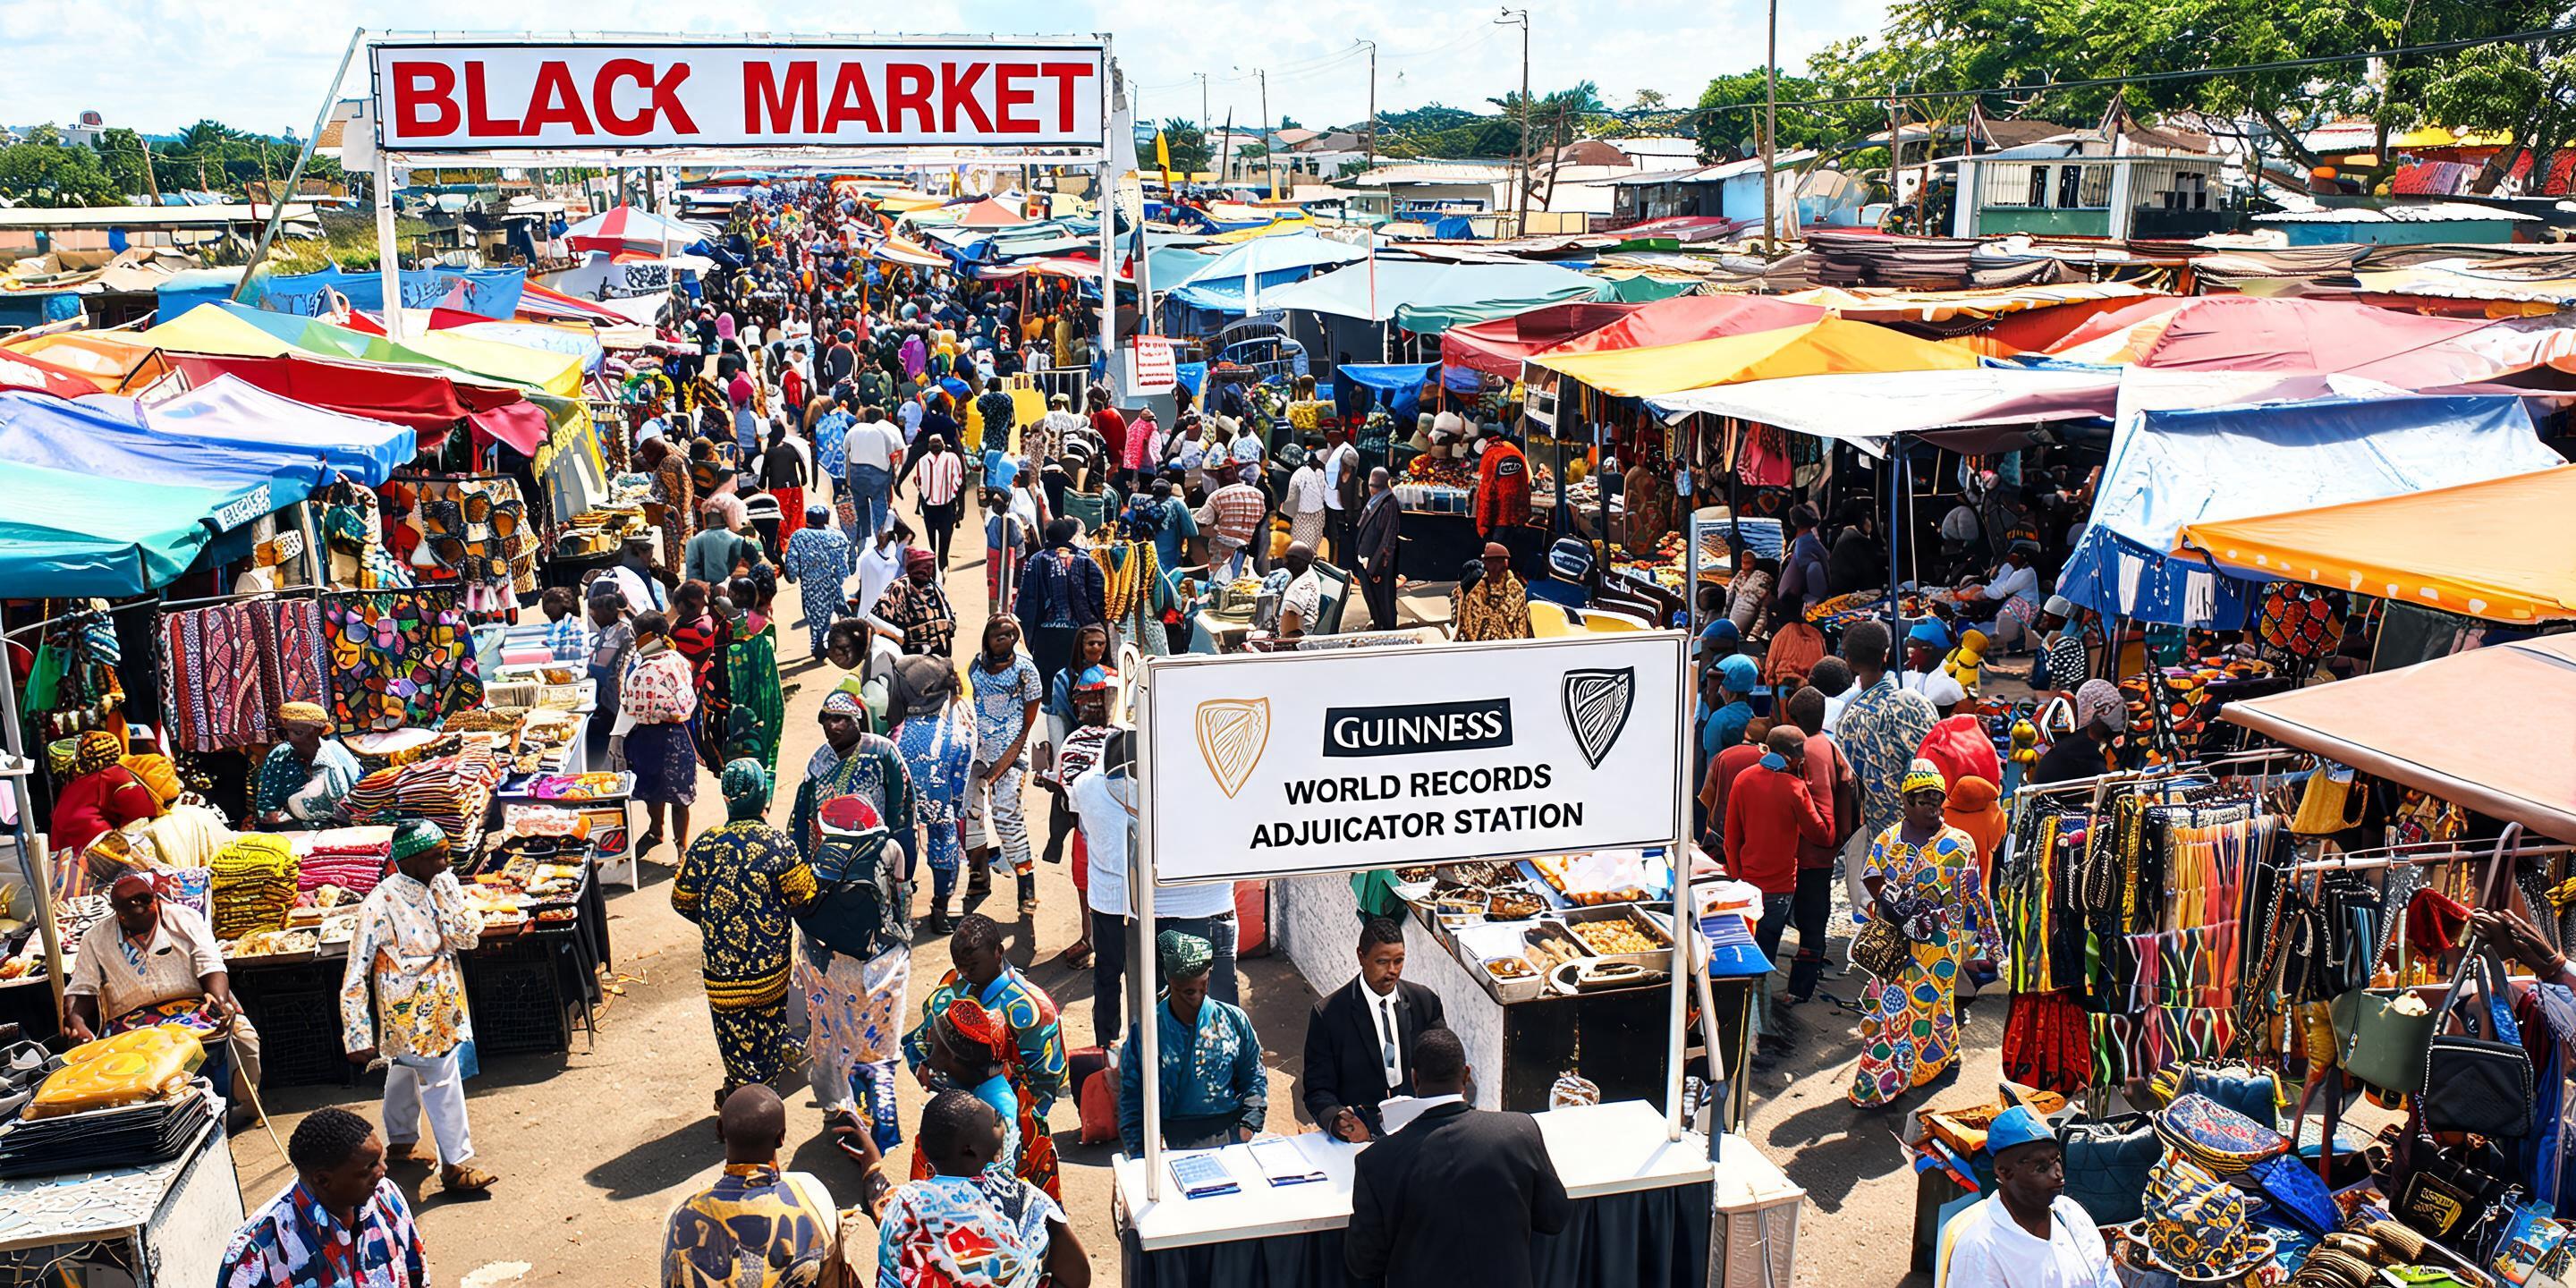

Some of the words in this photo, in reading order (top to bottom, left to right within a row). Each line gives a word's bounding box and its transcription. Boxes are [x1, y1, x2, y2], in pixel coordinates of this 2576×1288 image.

[392, 58, 700, 138] BLACK
[743, 61, 1094, 135] MARKET
[1333, 709, 1504, 750] GUINNESS
[1284, 775, 1402, 806] WORLD
[1411, 763, 1552, 798] RECORDS
[1250, 811, 1445, 850] ADJUICATOR
[1453, 801, 1583, 835] STATION
